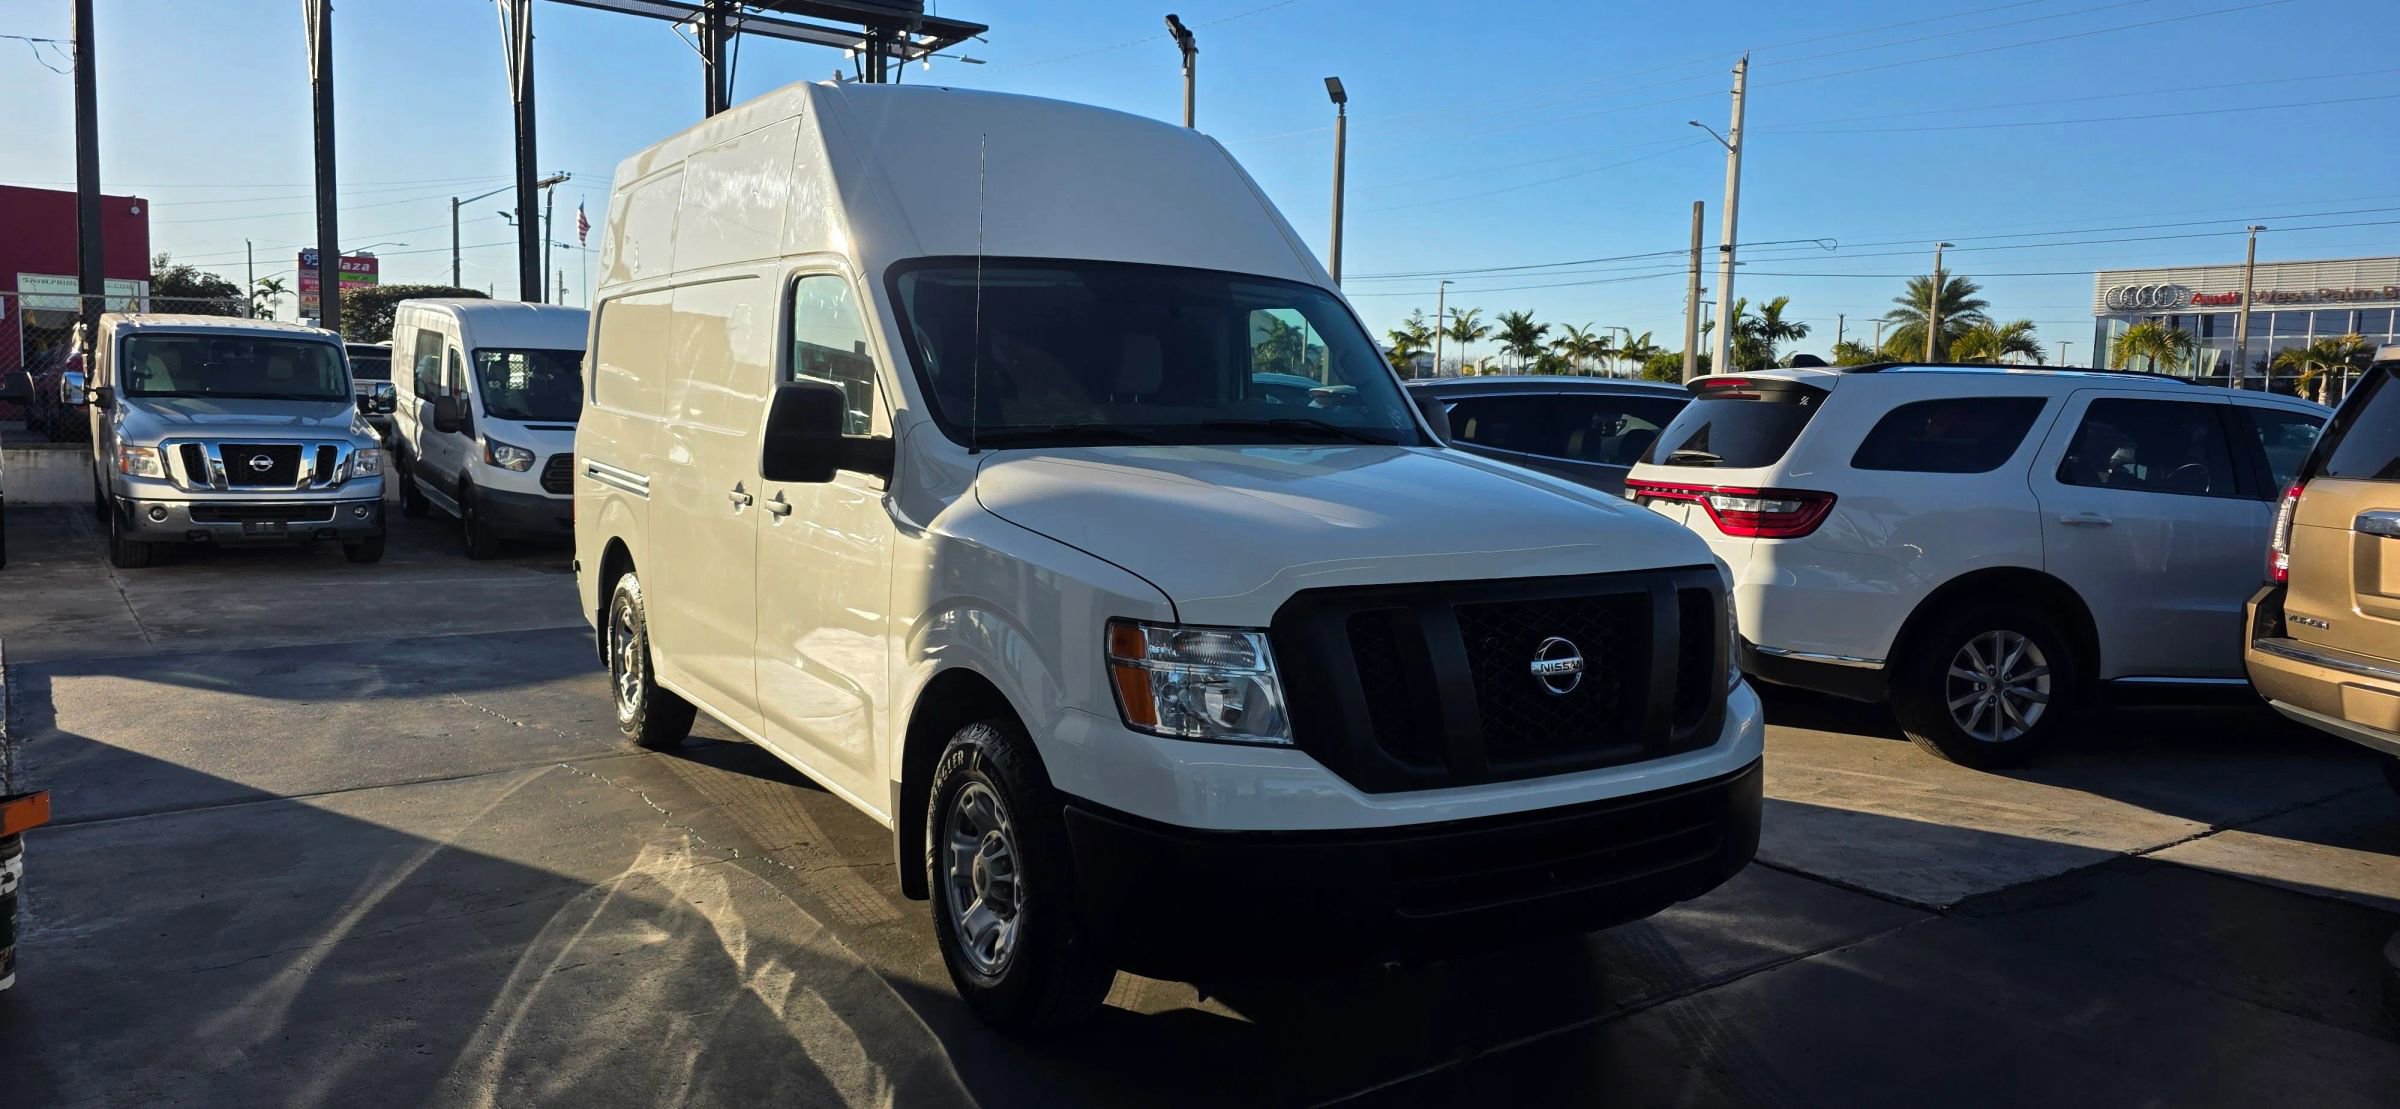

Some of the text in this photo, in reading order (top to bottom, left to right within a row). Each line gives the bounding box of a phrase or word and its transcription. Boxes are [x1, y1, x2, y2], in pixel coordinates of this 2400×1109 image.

[338, 258, 371, 271] laza
[2190, 291, 2239, 305] Audi
[2317, 286, 2377, 302] Palm
[1540, 659, 1581, 673] NISSAN
